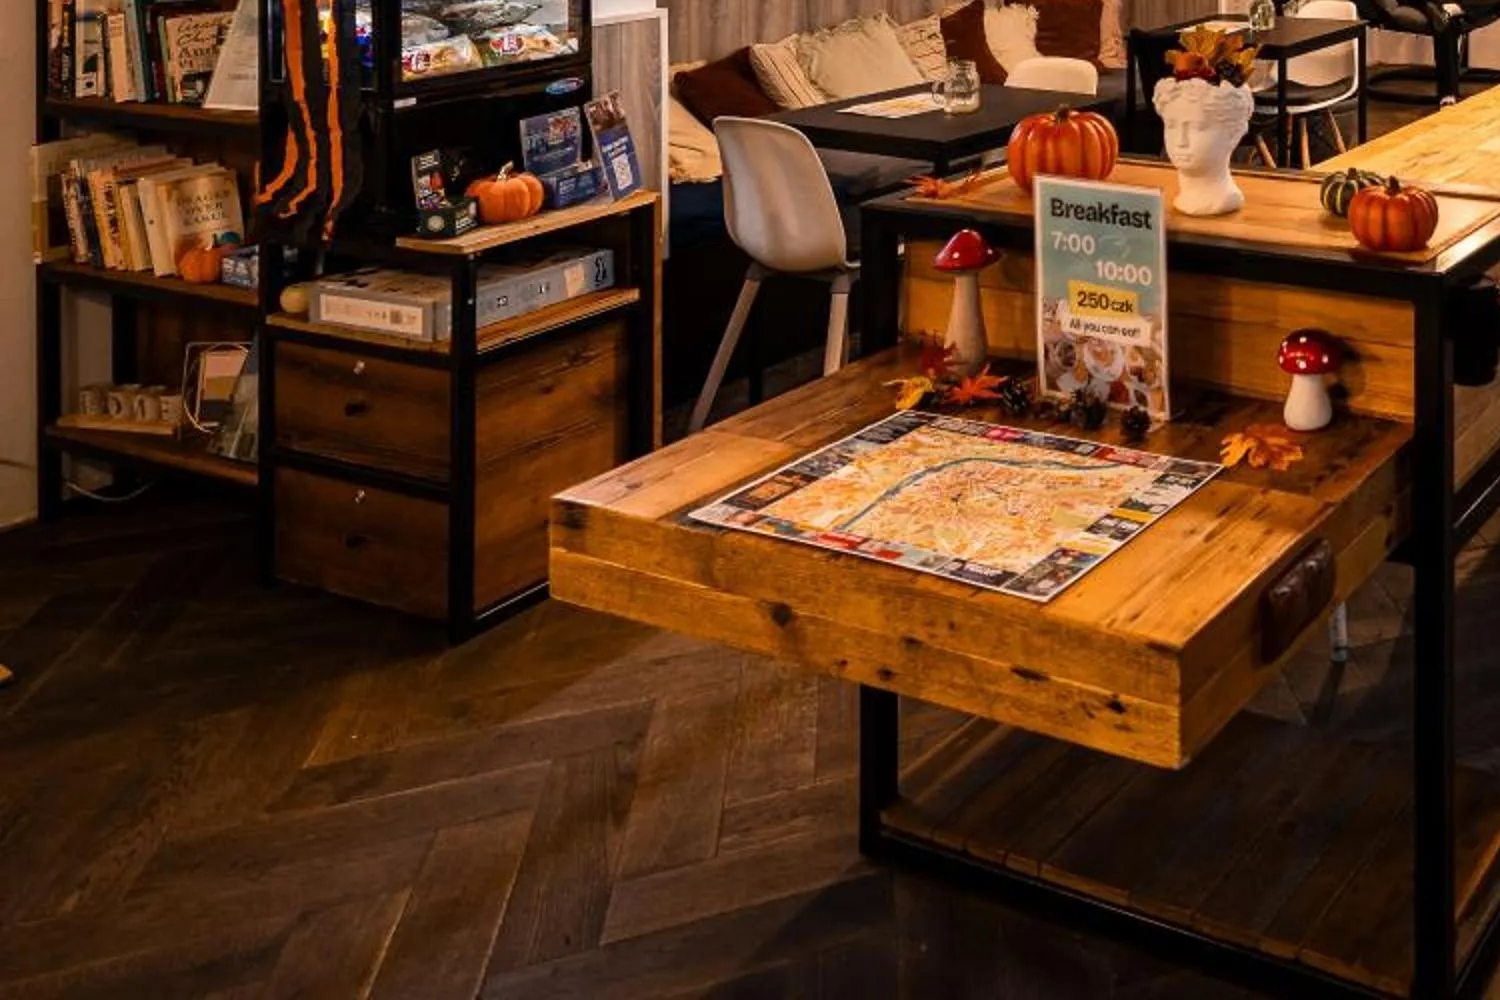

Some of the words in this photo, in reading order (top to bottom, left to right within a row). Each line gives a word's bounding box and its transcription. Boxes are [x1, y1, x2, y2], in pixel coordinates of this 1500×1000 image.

[1050, 196, 1153, 231] Breakfast
[1050, 231, 1096, 256] 7:00
[1095, 259, 1153, 287] 10:00
[1077, 290, 1109, 311] 250
